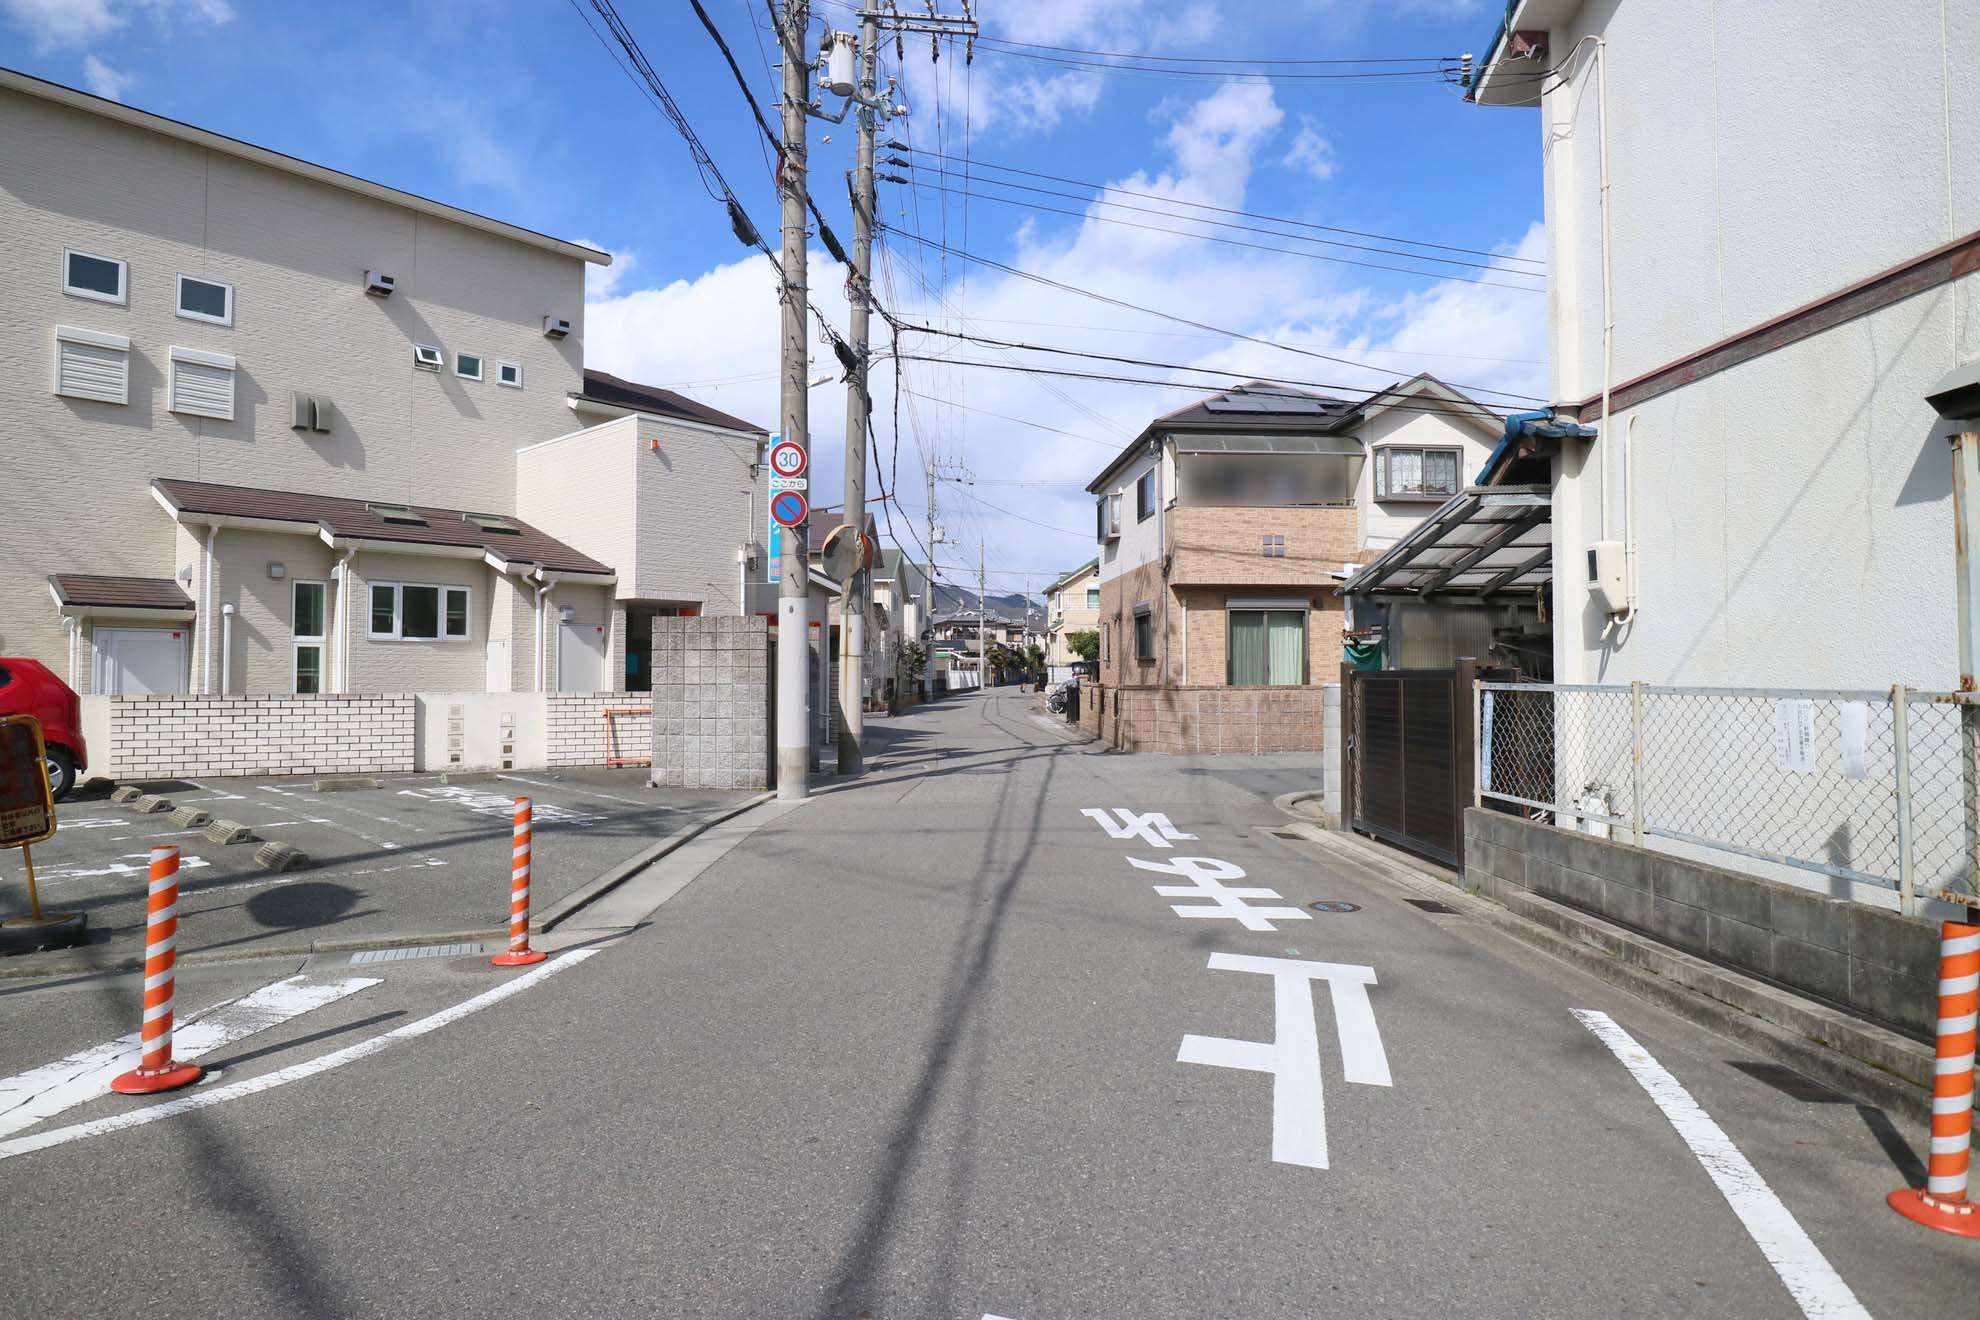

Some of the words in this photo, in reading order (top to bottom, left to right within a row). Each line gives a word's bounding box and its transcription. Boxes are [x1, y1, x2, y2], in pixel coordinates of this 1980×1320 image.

[779, 452, 798, 467] 30
[772, 480, 805, 488] ここから
[1080, 808, 1393, 1169] 止まれ
